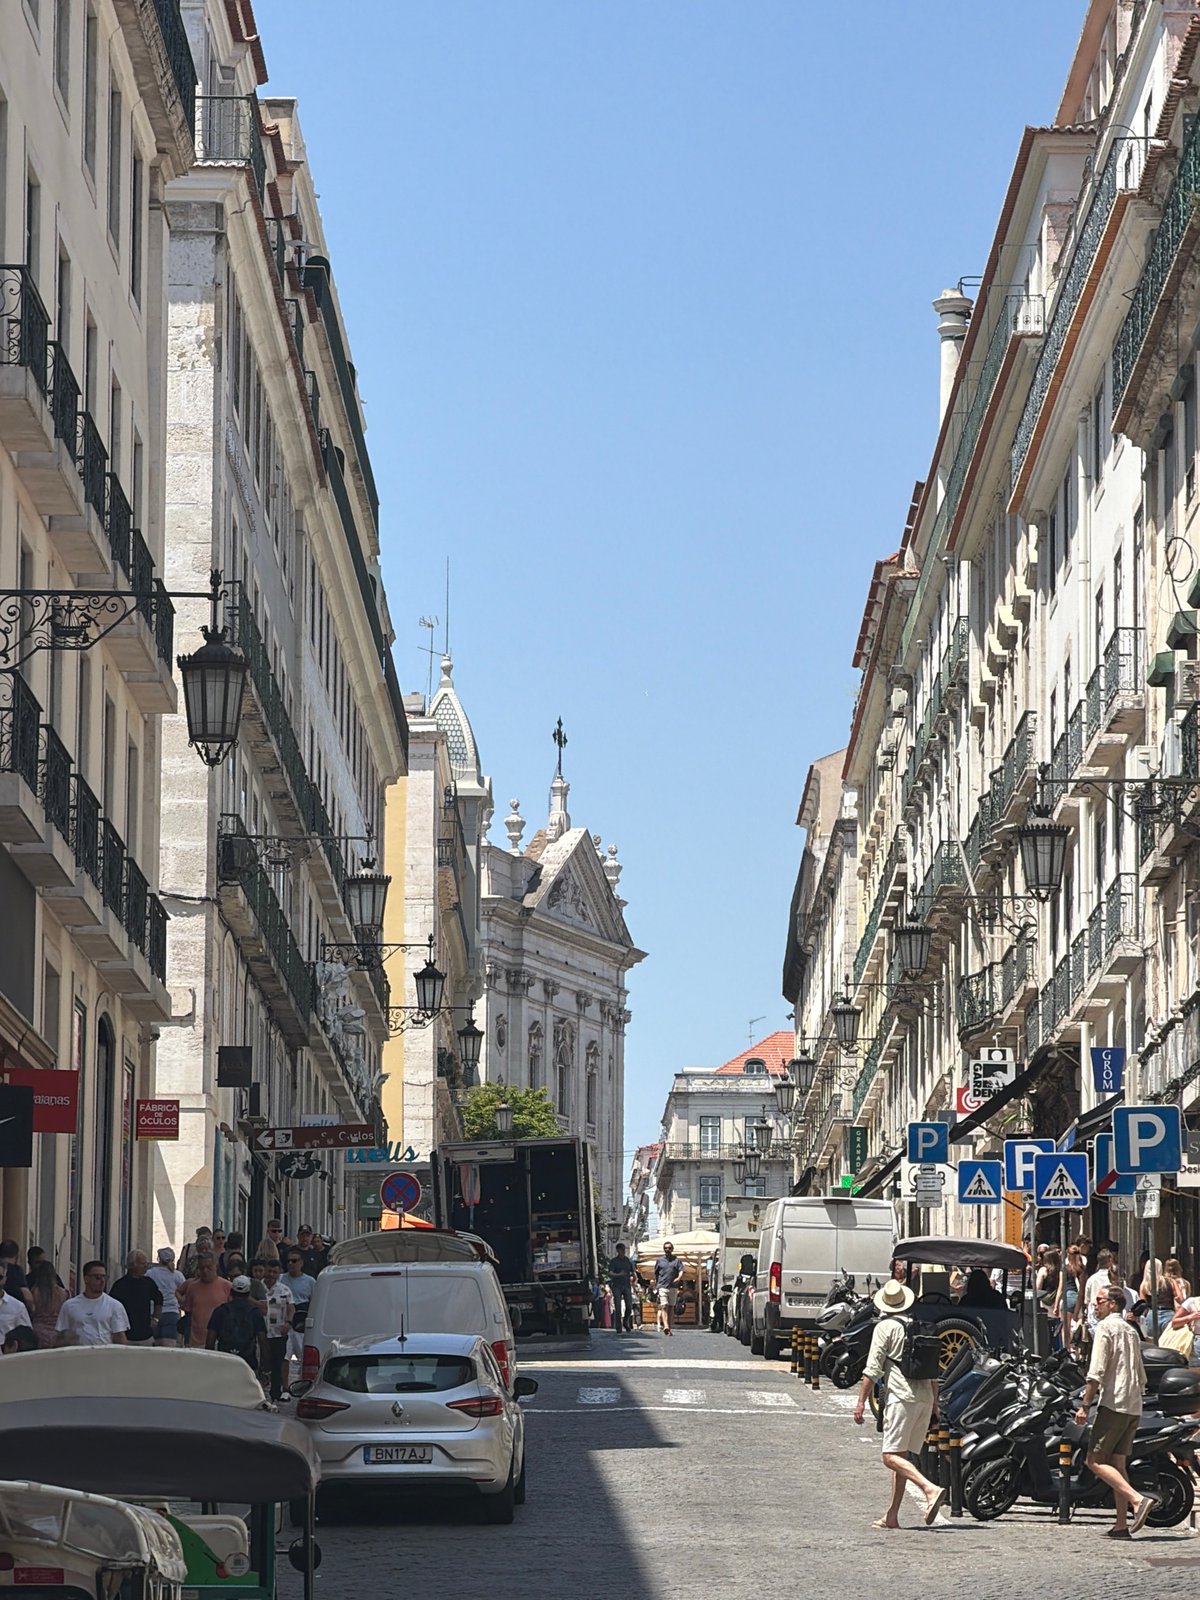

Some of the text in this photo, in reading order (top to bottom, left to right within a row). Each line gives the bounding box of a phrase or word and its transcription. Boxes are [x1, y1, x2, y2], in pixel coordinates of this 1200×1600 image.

[1102, 1050, 1113, 1090] GROM
[33, 1095, 70, 1106] aianas
[140, 1103, 178, 1111] FÁBRICA
[140, 1116, 177, 1125] ÓCULOS
[918, 1128, 939, 1159] P
[1128, 1113, 1166, 1167] P
[1015, 1145, 1044, 1187] P
